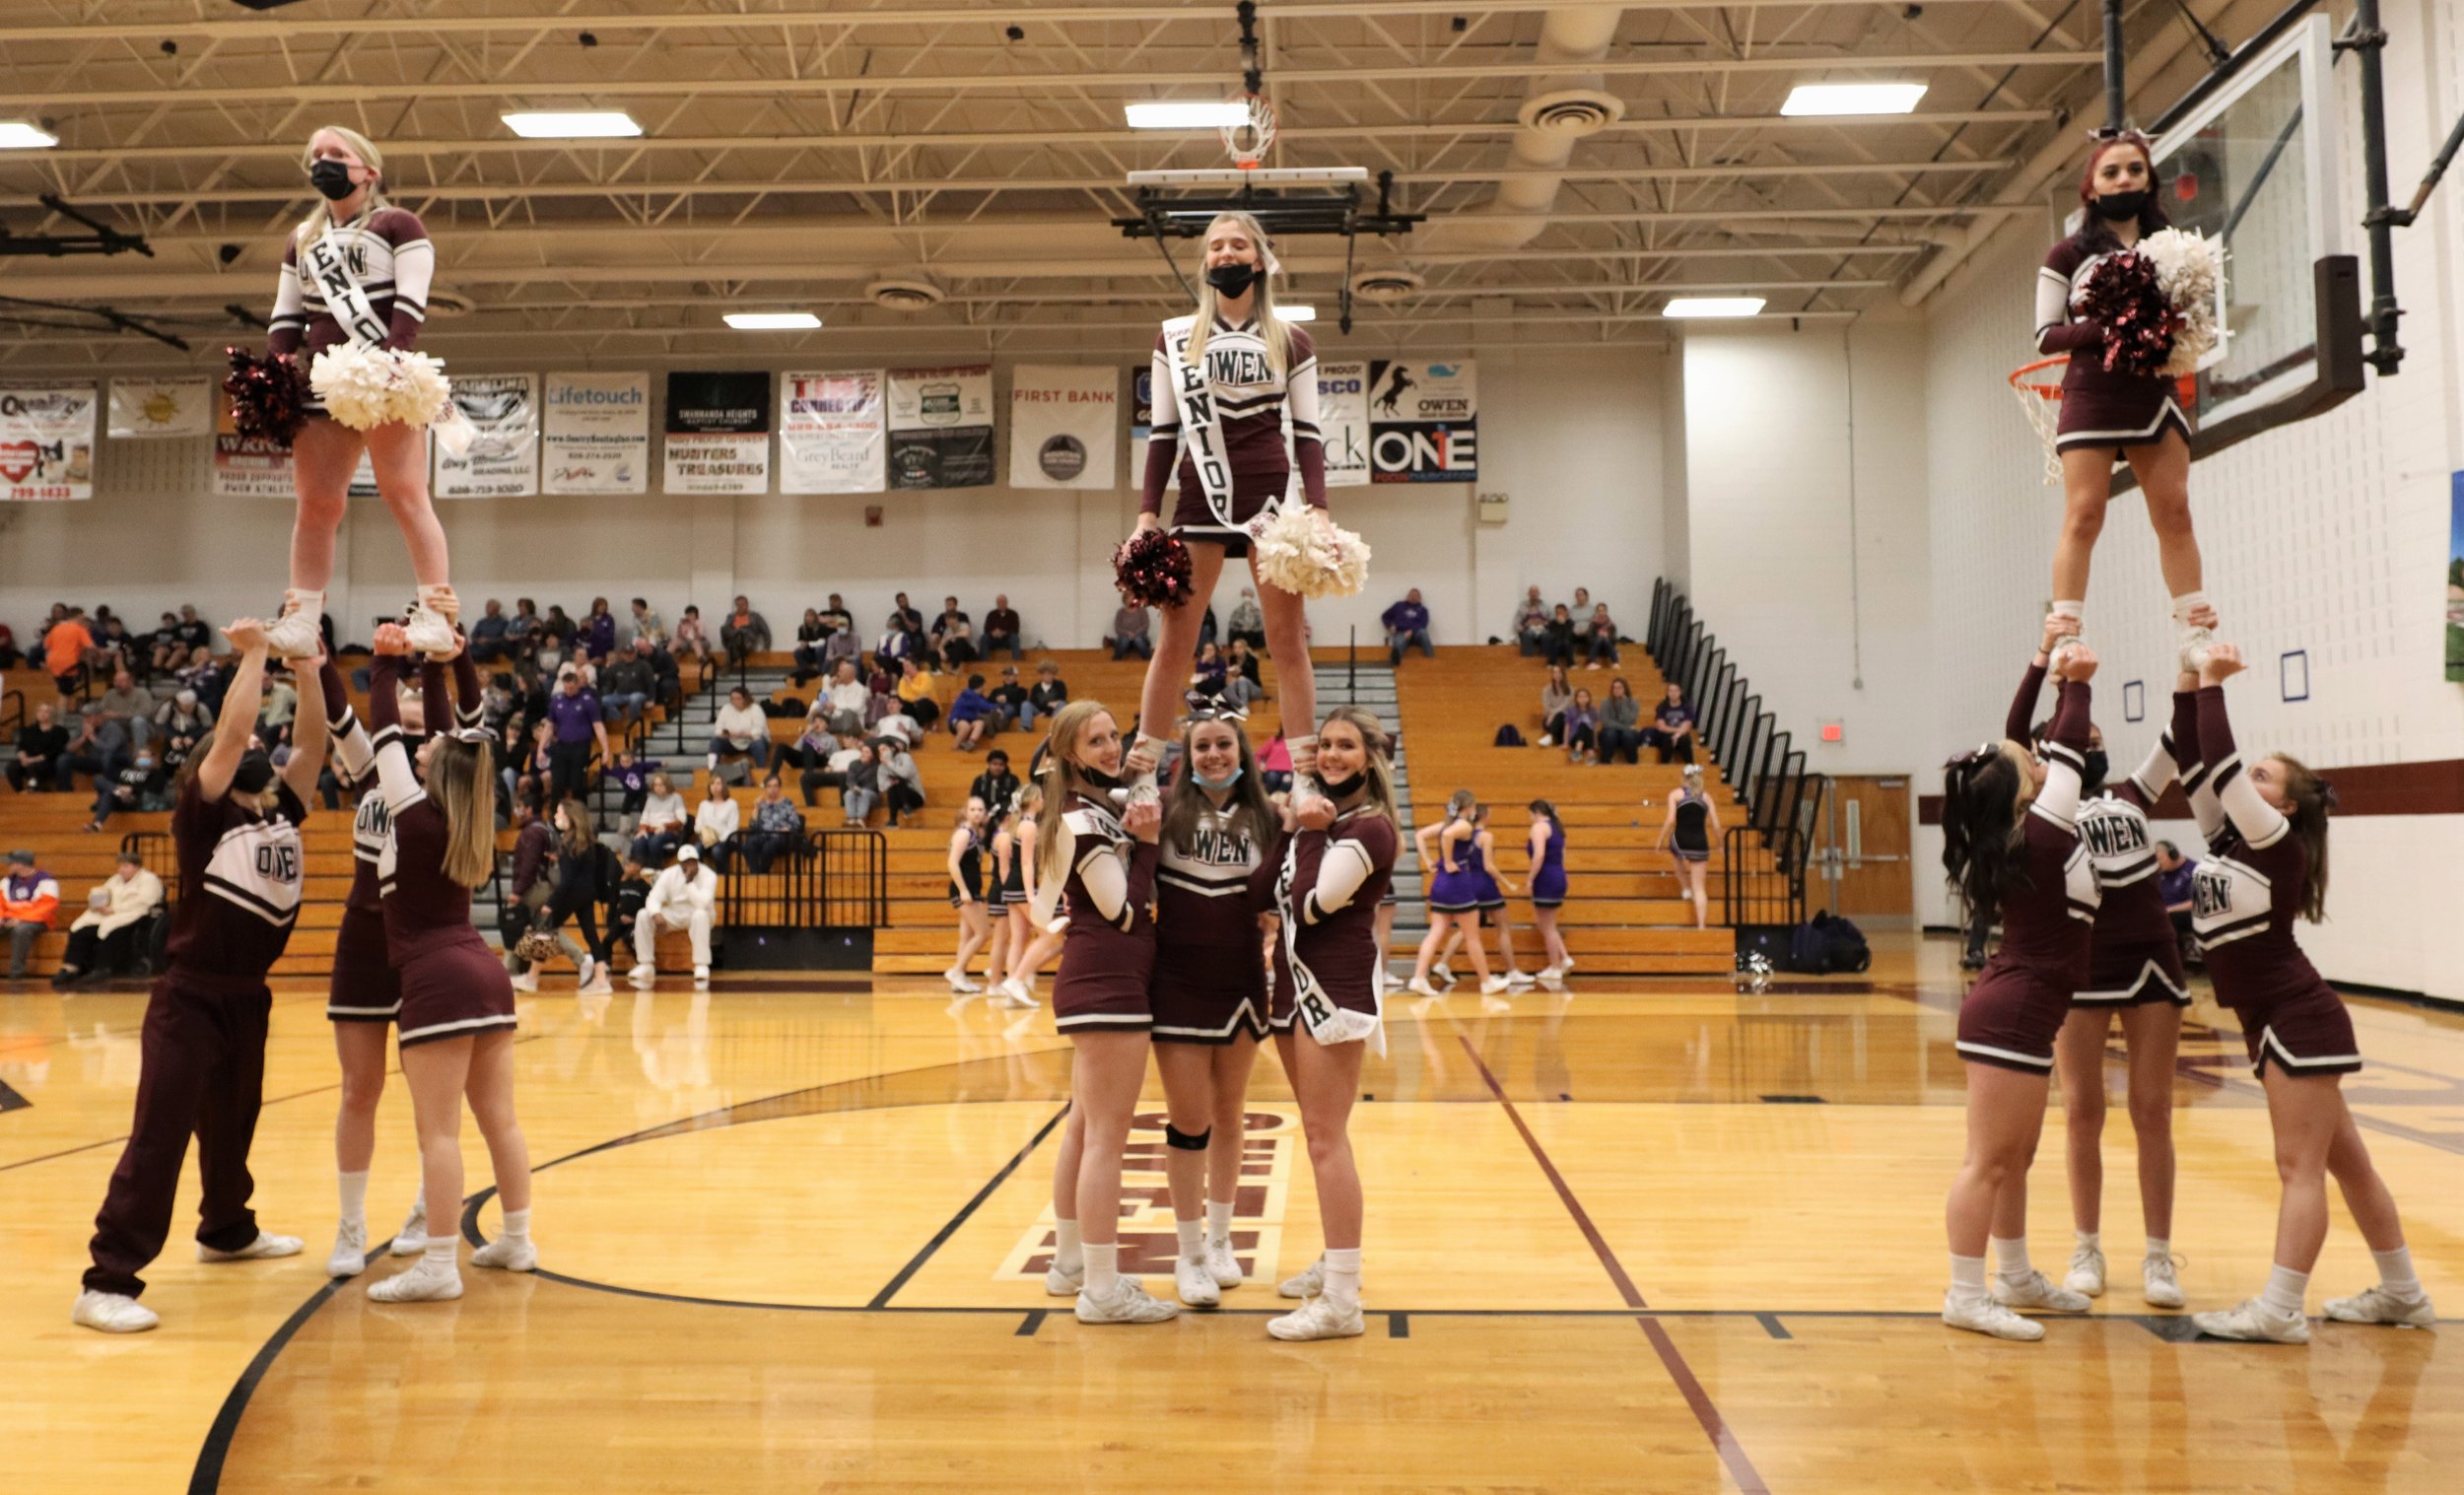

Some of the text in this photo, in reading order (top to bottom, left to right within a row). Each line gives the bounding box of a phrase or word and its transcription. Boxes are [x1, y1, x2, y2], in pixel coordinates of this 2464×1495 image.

[549, 386, 642, 404] Lifetouch
[1014, 389, 1116, 403] FIRST BANK
[1418, 398, 1469, 411] OWEN
[669, 448, 736, 460] HUNTERS
[677, 463, 764, 475] TREASURES
[2075, 814, 2149, 856] WEN
[1176, 828, 1252, 866] WEN
